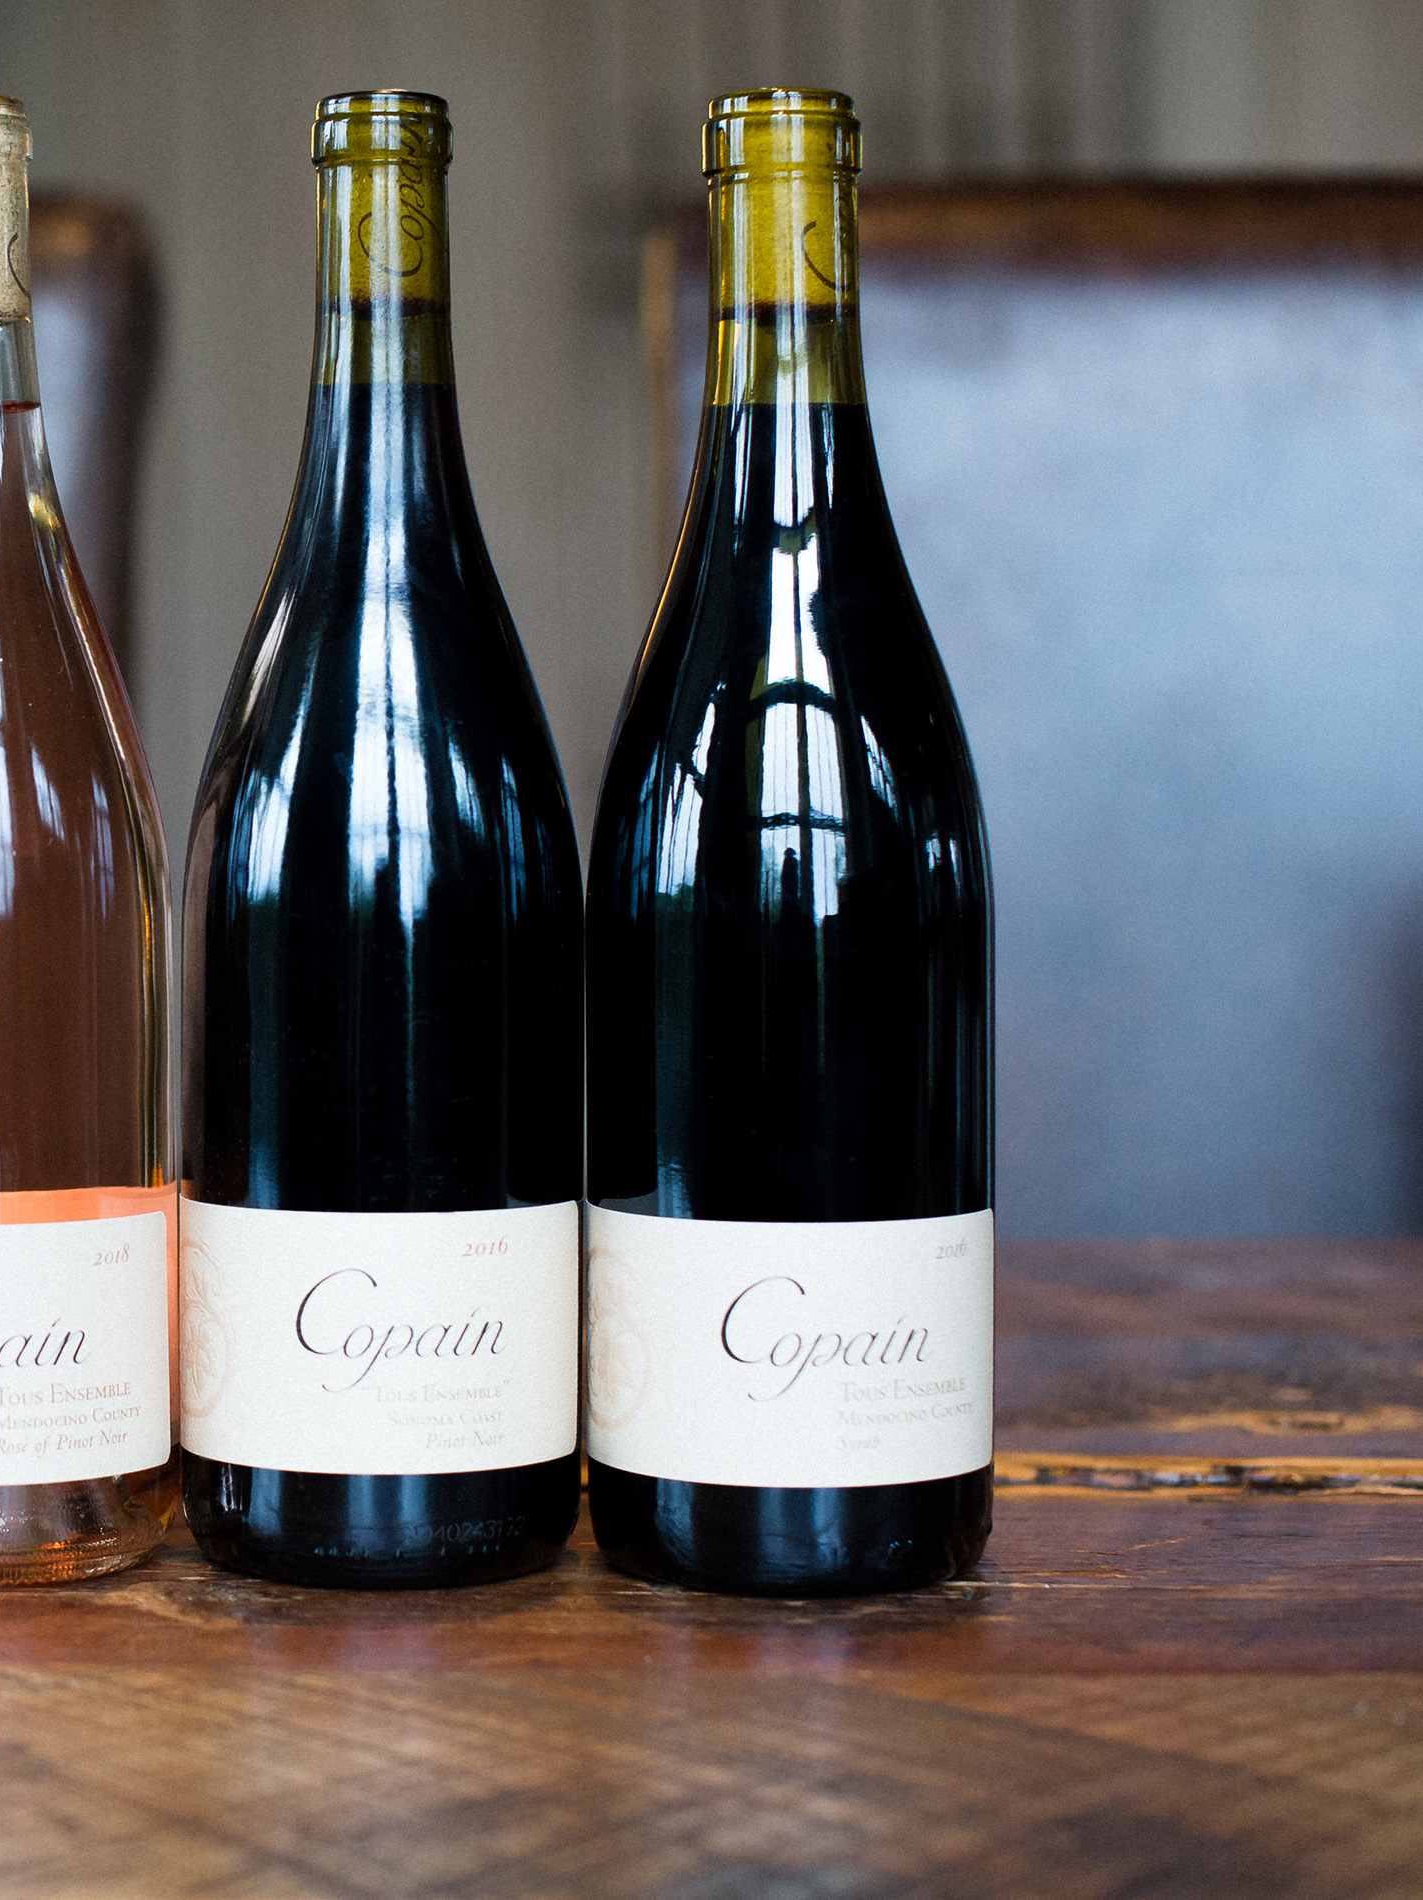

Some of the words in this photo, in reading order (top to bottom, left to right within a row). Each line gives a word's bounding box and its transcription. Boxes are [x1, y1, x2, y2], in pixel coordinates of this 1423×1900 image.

[93, 1243, 130, 1267] 2018
[461, 1235, 509, 1257] 2016
[934, 1237, 967, 1260] 2016
[296, 1268, 509, 1393] Copain
[721, 1276, 930, 1401] Copain
[34, 1436, 50, 1459] of
[56, 1433, 94, 1452] Pinot
[99, 1429, 129, 1446] Noir
